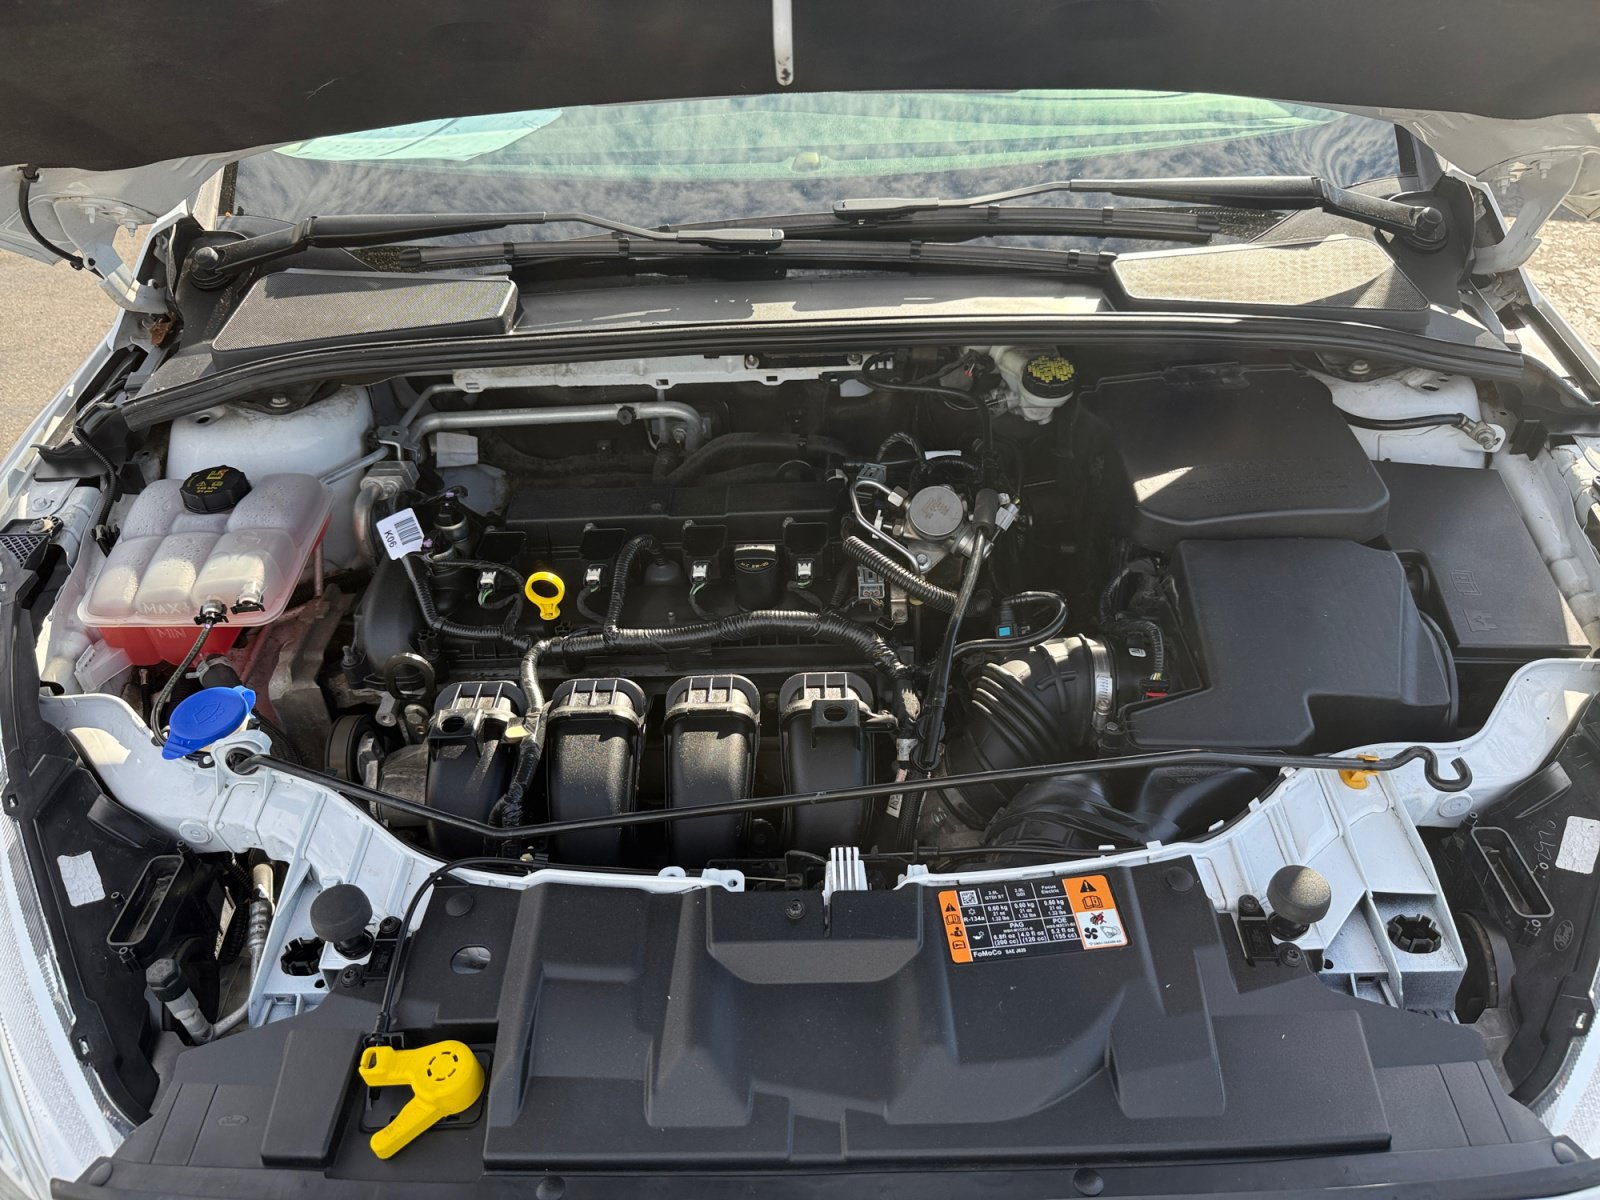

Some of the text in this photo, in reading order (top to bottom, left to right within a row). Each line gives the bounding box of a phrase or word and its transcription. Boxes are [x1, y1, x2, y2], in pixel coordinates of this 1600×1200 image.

[384, 530, 398, 548] K06
[142, 602, 180, 615] MAX
[155, 627, 187, 640] MIN
[973, 949, 1002, 957] FoMoCo
